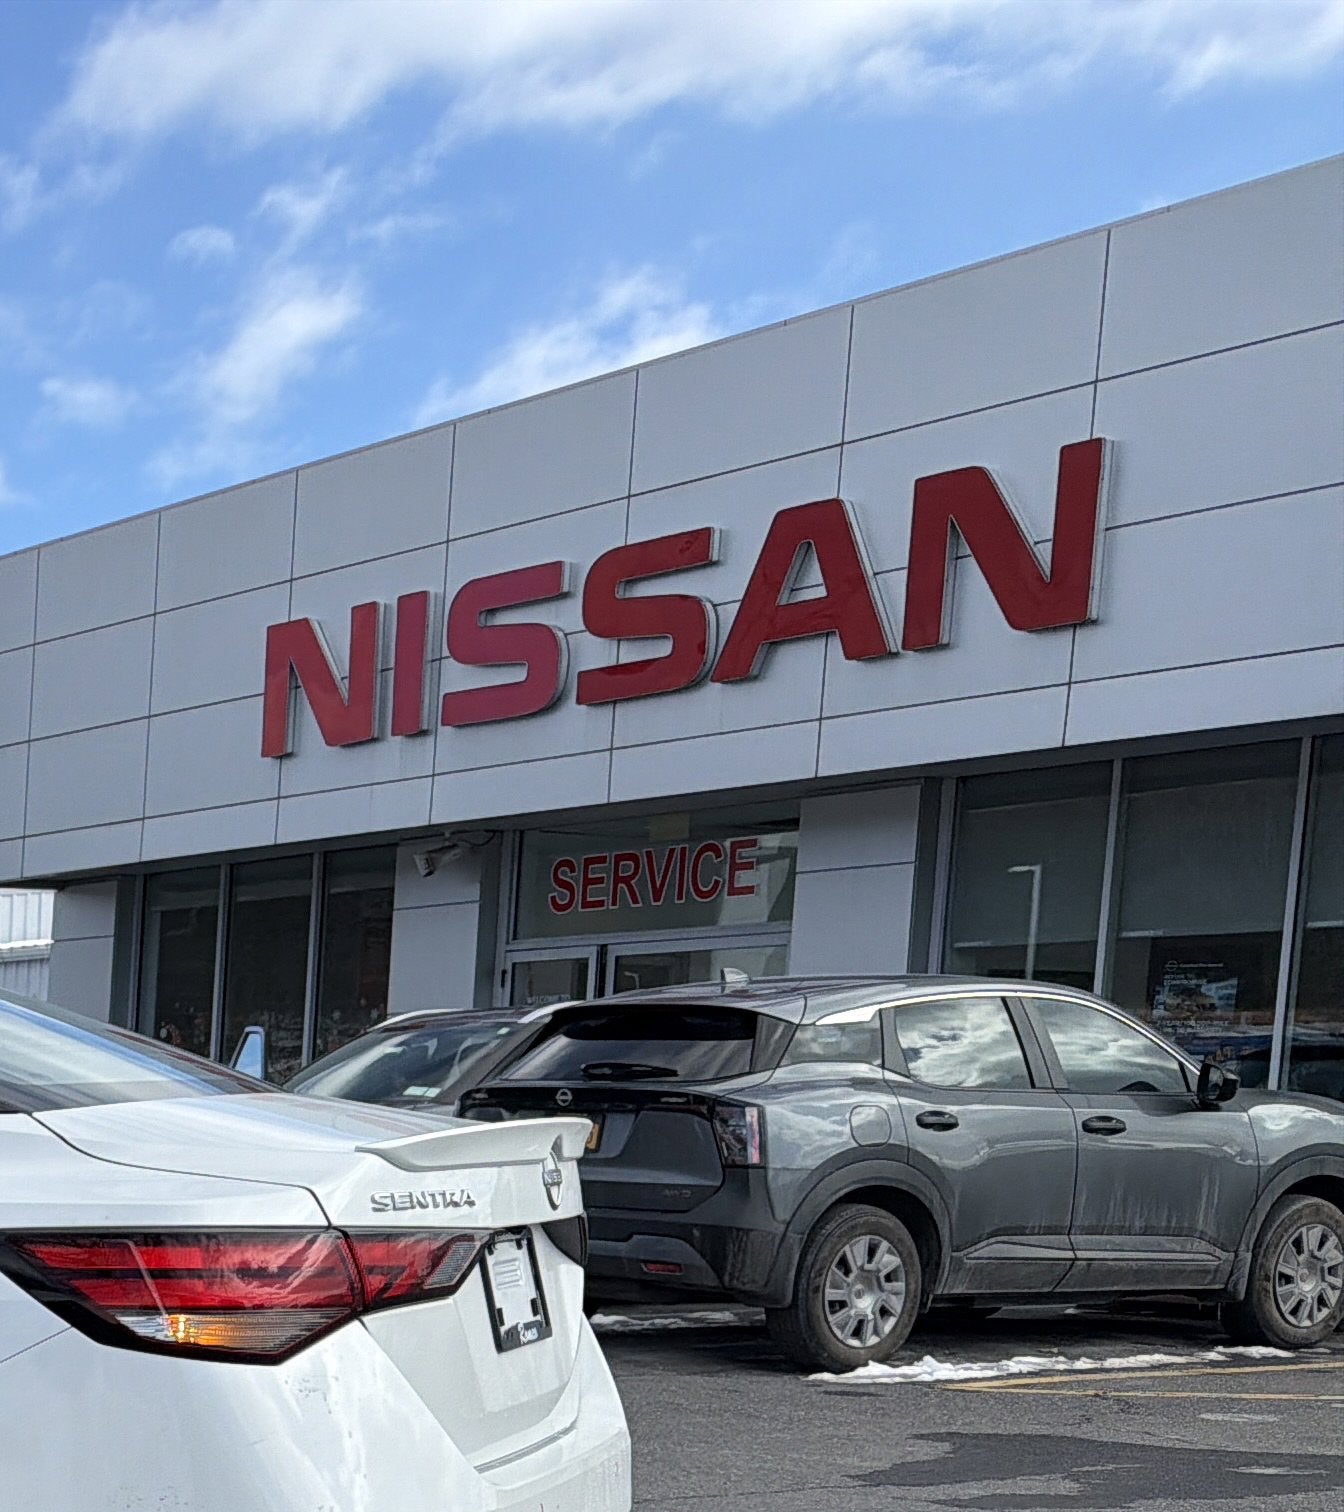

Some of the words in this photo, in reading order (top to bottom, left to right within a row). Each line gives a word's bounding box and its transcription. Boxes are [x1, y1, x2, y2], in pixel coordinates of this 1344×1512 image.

[261, 437, 1111, 758] NISSAN
[548, 837, 760, 915] SERVICE
[370, 1188, 477, 1213] SENTRA
